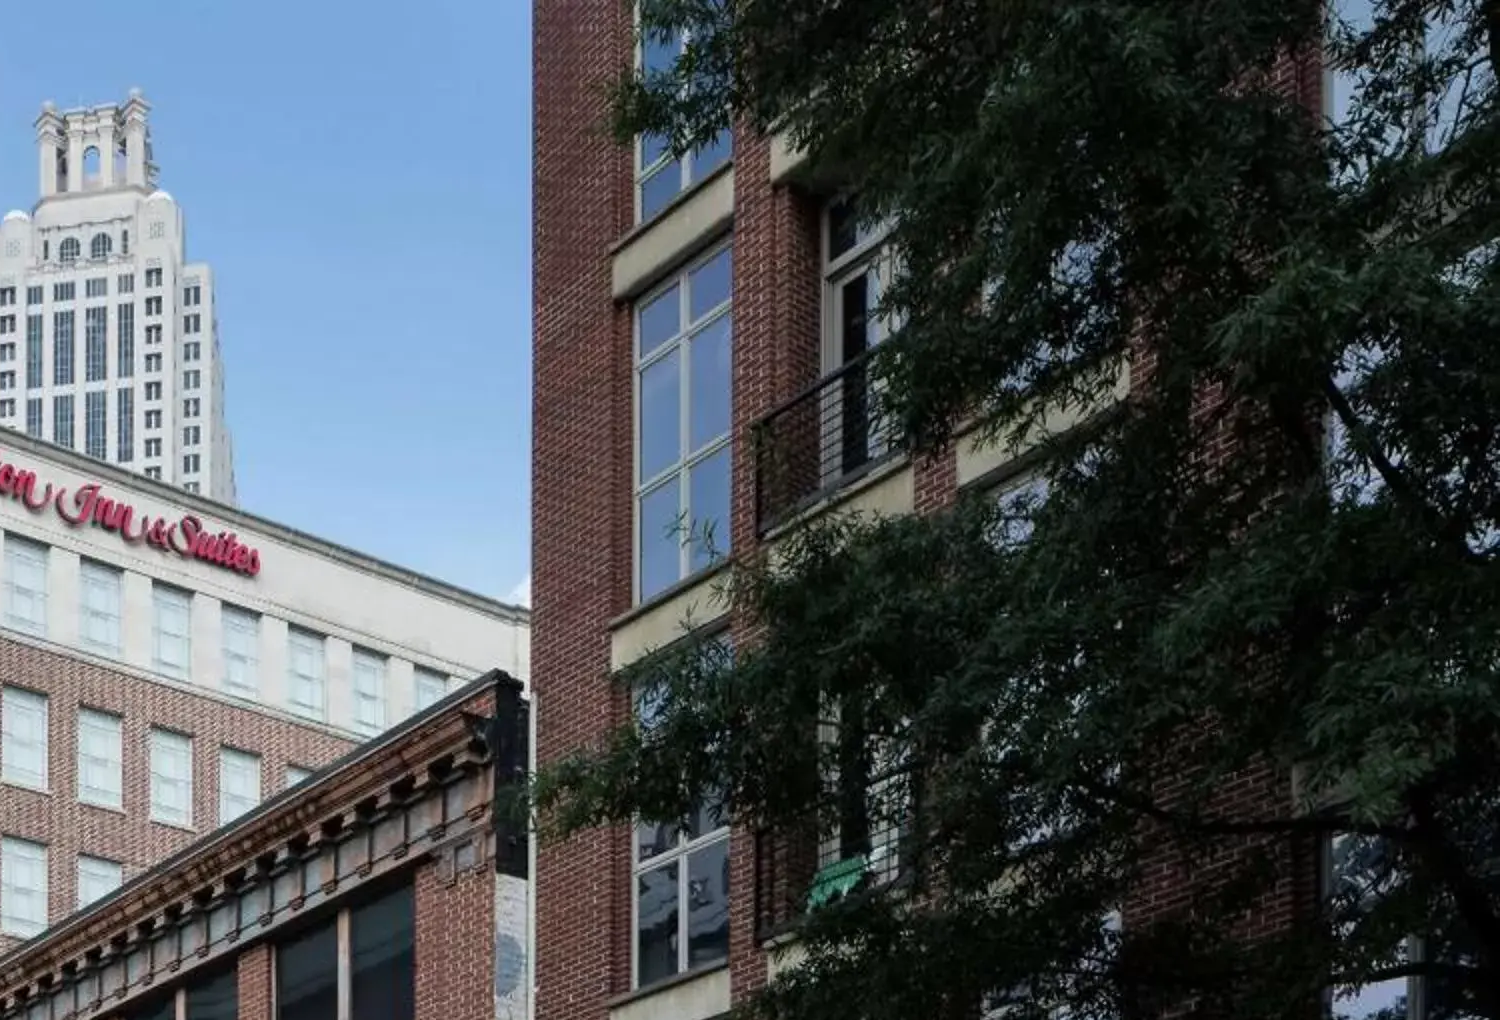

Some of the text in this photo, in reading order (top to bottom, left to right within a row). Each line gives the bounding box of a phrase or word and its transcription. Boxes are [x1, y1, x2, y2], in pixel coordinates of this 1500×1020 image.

[56, 484, 148, 542] Inn
[146, 517, 168, 551] &
[167, 515, 261, 576] Suites
